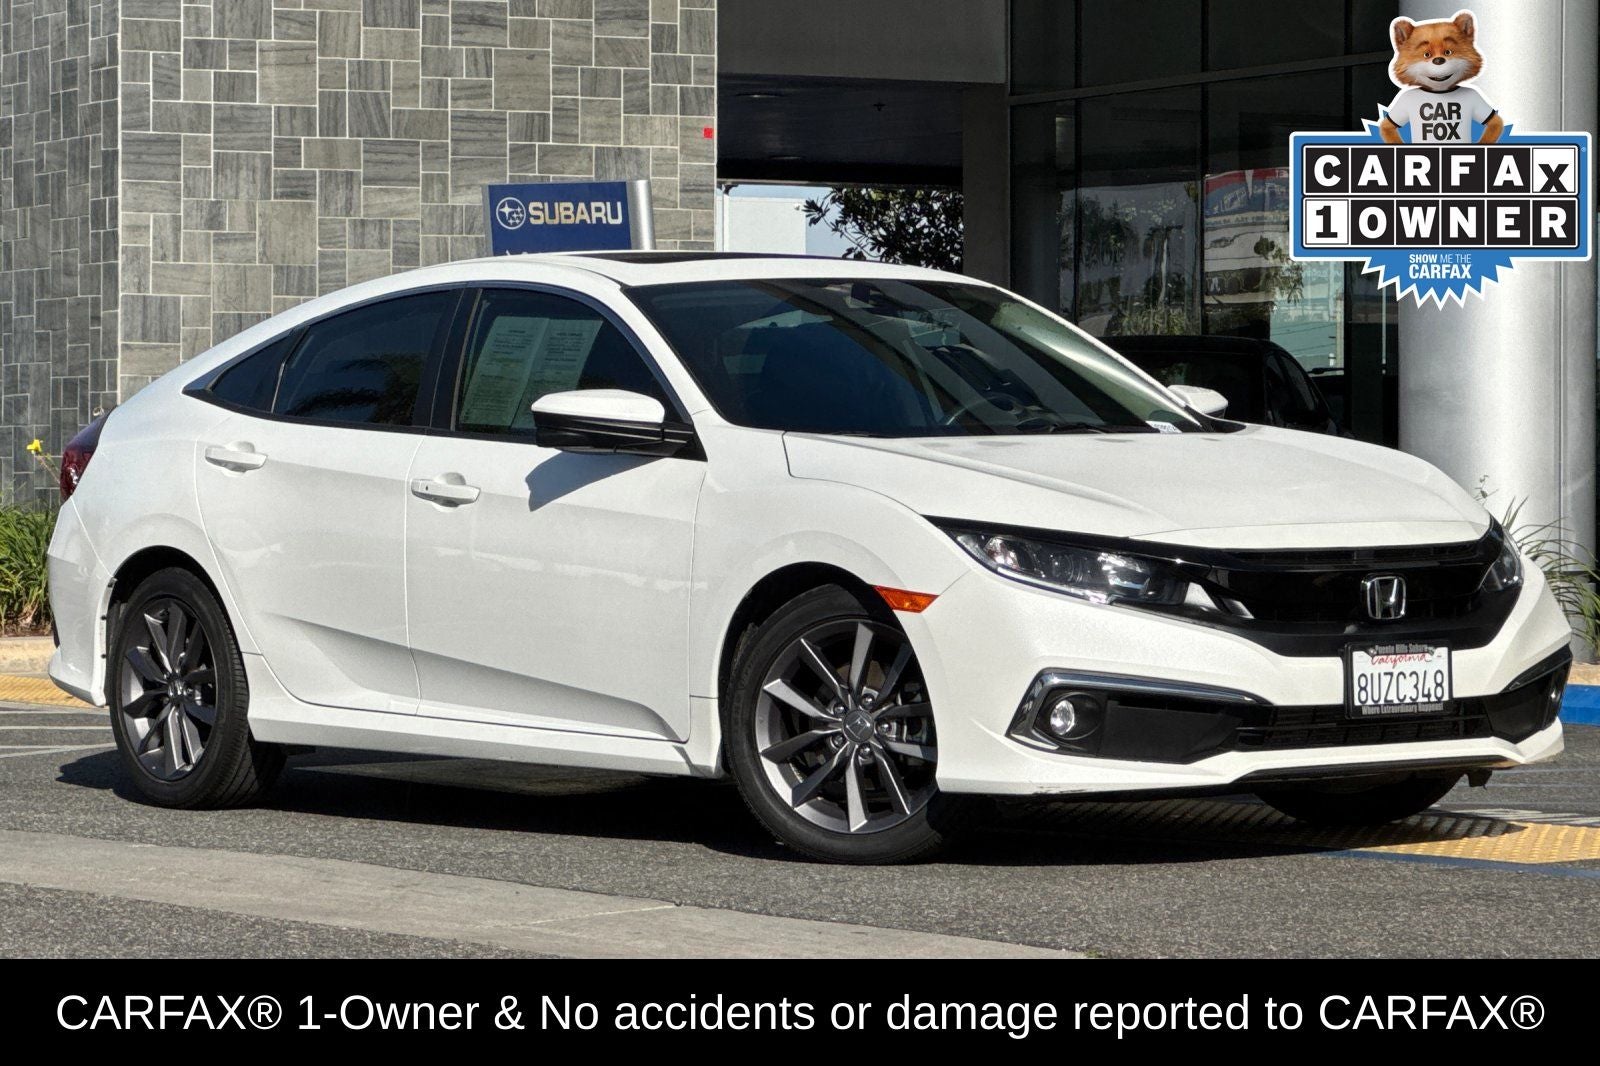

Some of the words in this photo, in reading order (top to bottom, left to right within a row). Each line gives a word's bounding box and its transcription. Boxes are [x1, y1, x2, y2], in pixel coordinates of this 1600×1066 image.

[528, 201, 623, 225] SUBARU
[1371, 654, 1432, 669] California
[1358, 669, 1444, 704] 8UZC348
